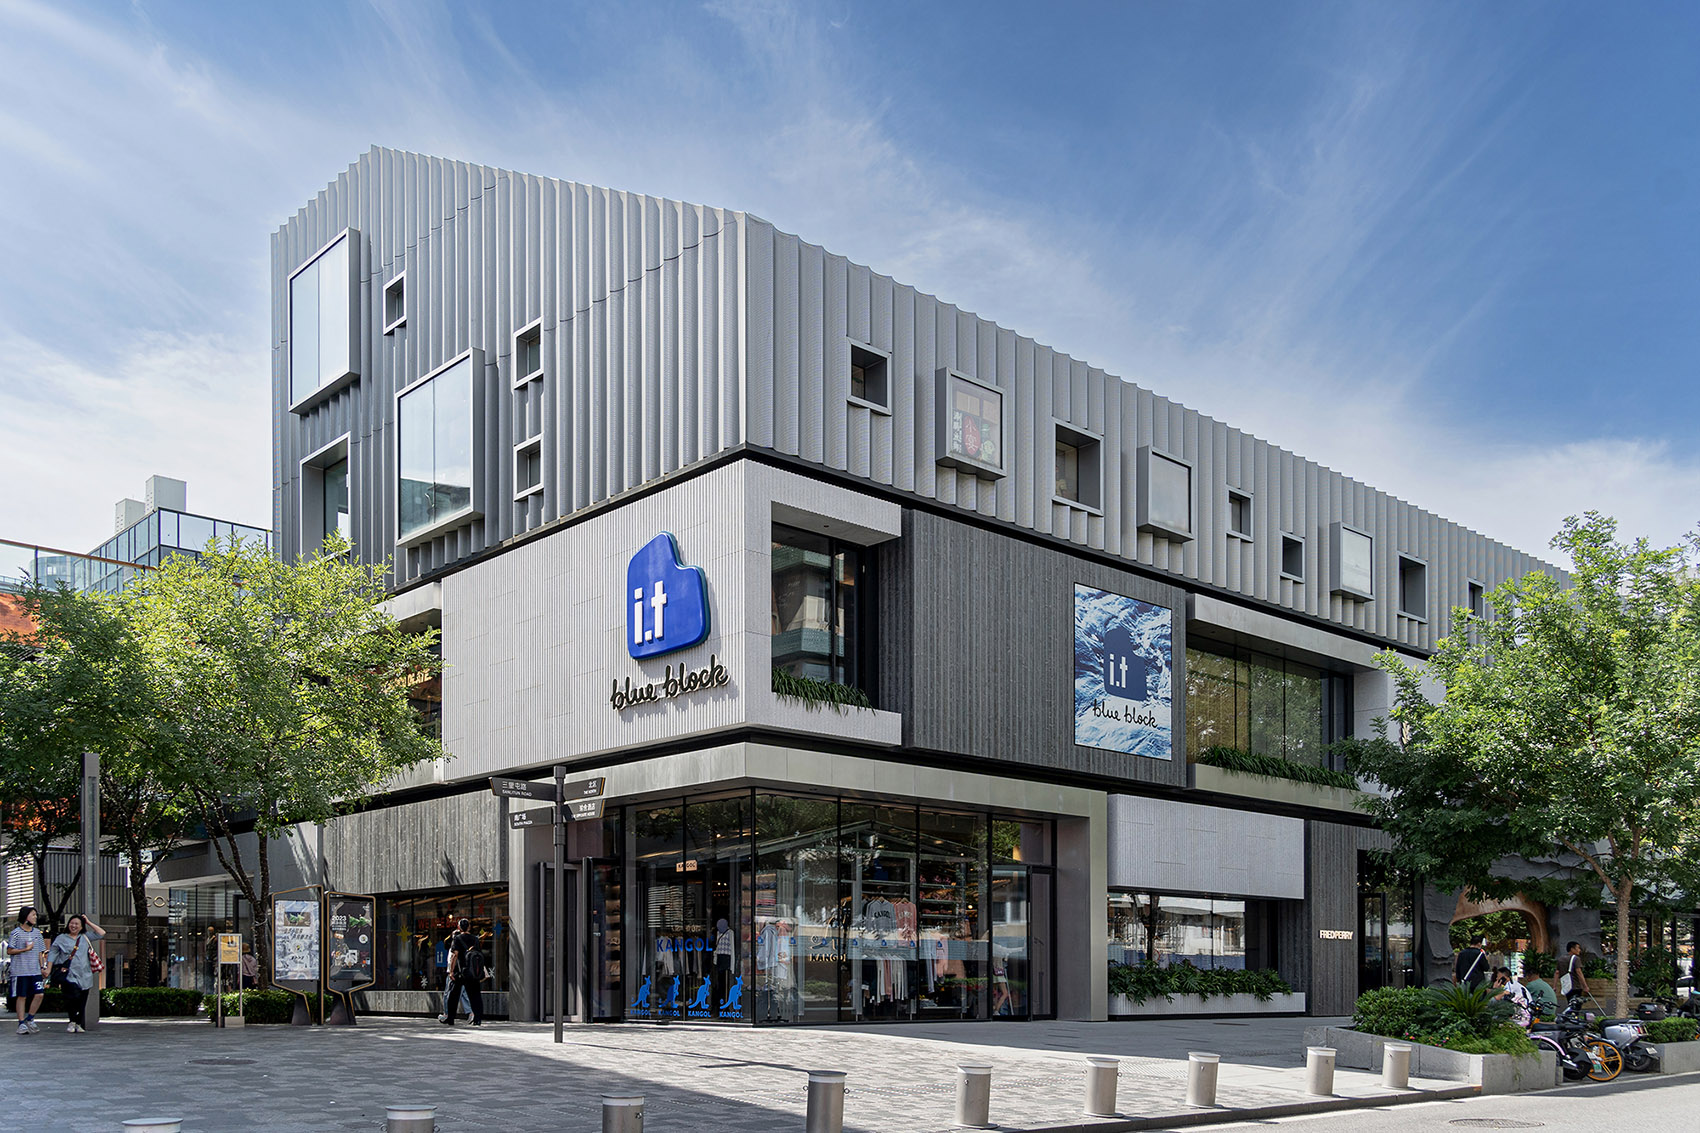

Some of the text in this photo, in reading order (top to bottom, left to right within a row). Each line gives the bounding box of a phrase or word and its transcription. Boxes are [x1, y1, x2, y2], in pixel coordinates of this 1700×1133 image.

[634, 580, 667, 645] i.t
[610, 653, 729, 710] blue block
[1109, 653, 1128, 688] i.t
[1093, 698, 1158, 728] blue block
[502, 780, 527, 791] 三里屯路
[656, 937, 713, 953] KANGOL
[687, 1010, 711, 1018] KANGOL
